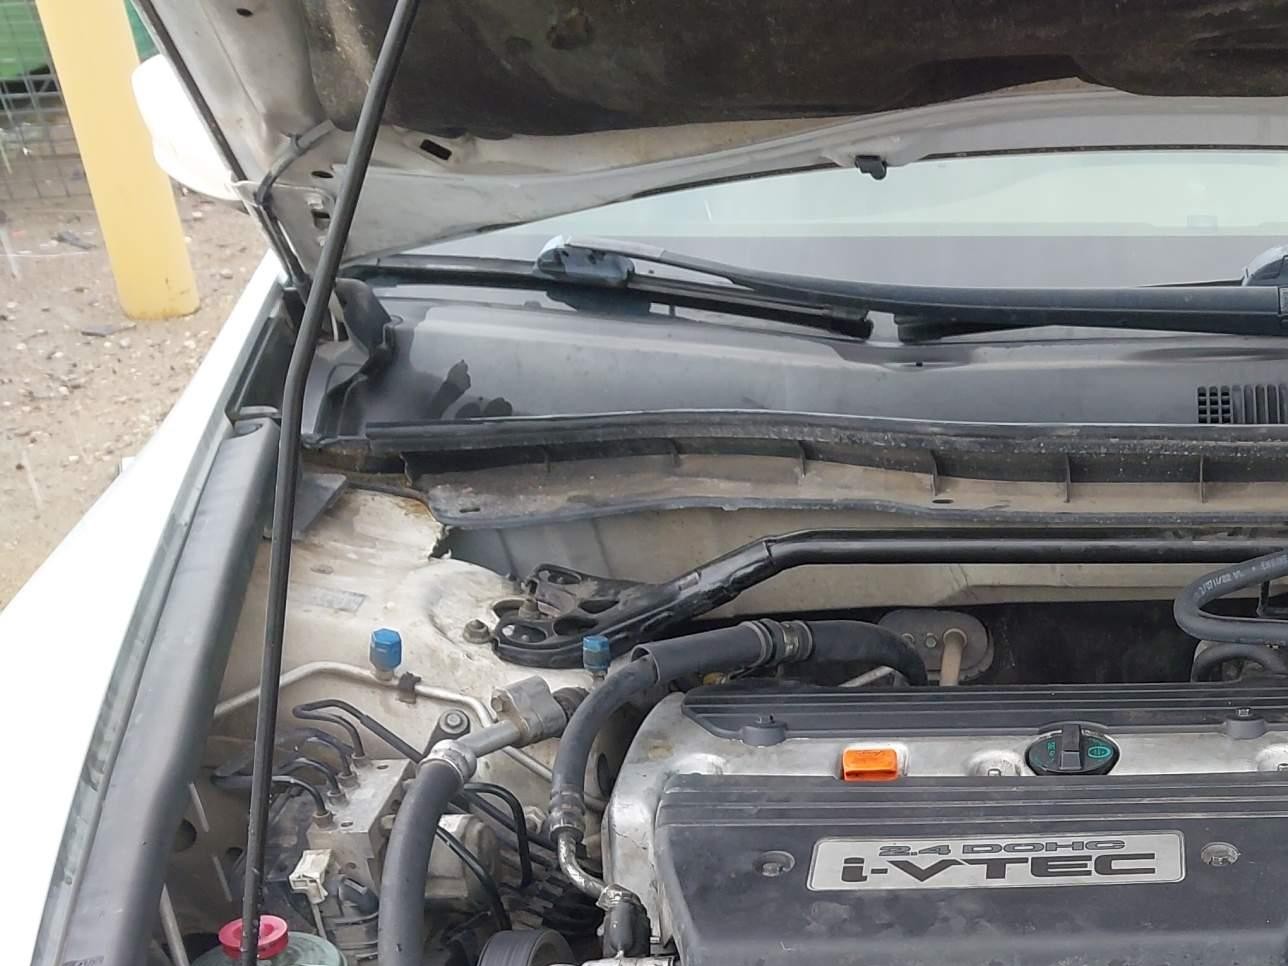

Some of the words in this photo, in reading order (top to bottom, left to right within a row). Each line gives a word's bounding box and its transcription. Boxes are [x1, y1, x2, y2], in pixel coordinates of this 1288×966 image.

[879, 844, 951, 856] 2.4
[962, 840, 1126, 854] DOHC
[841, 852, 1156, 883] i-VTEC
